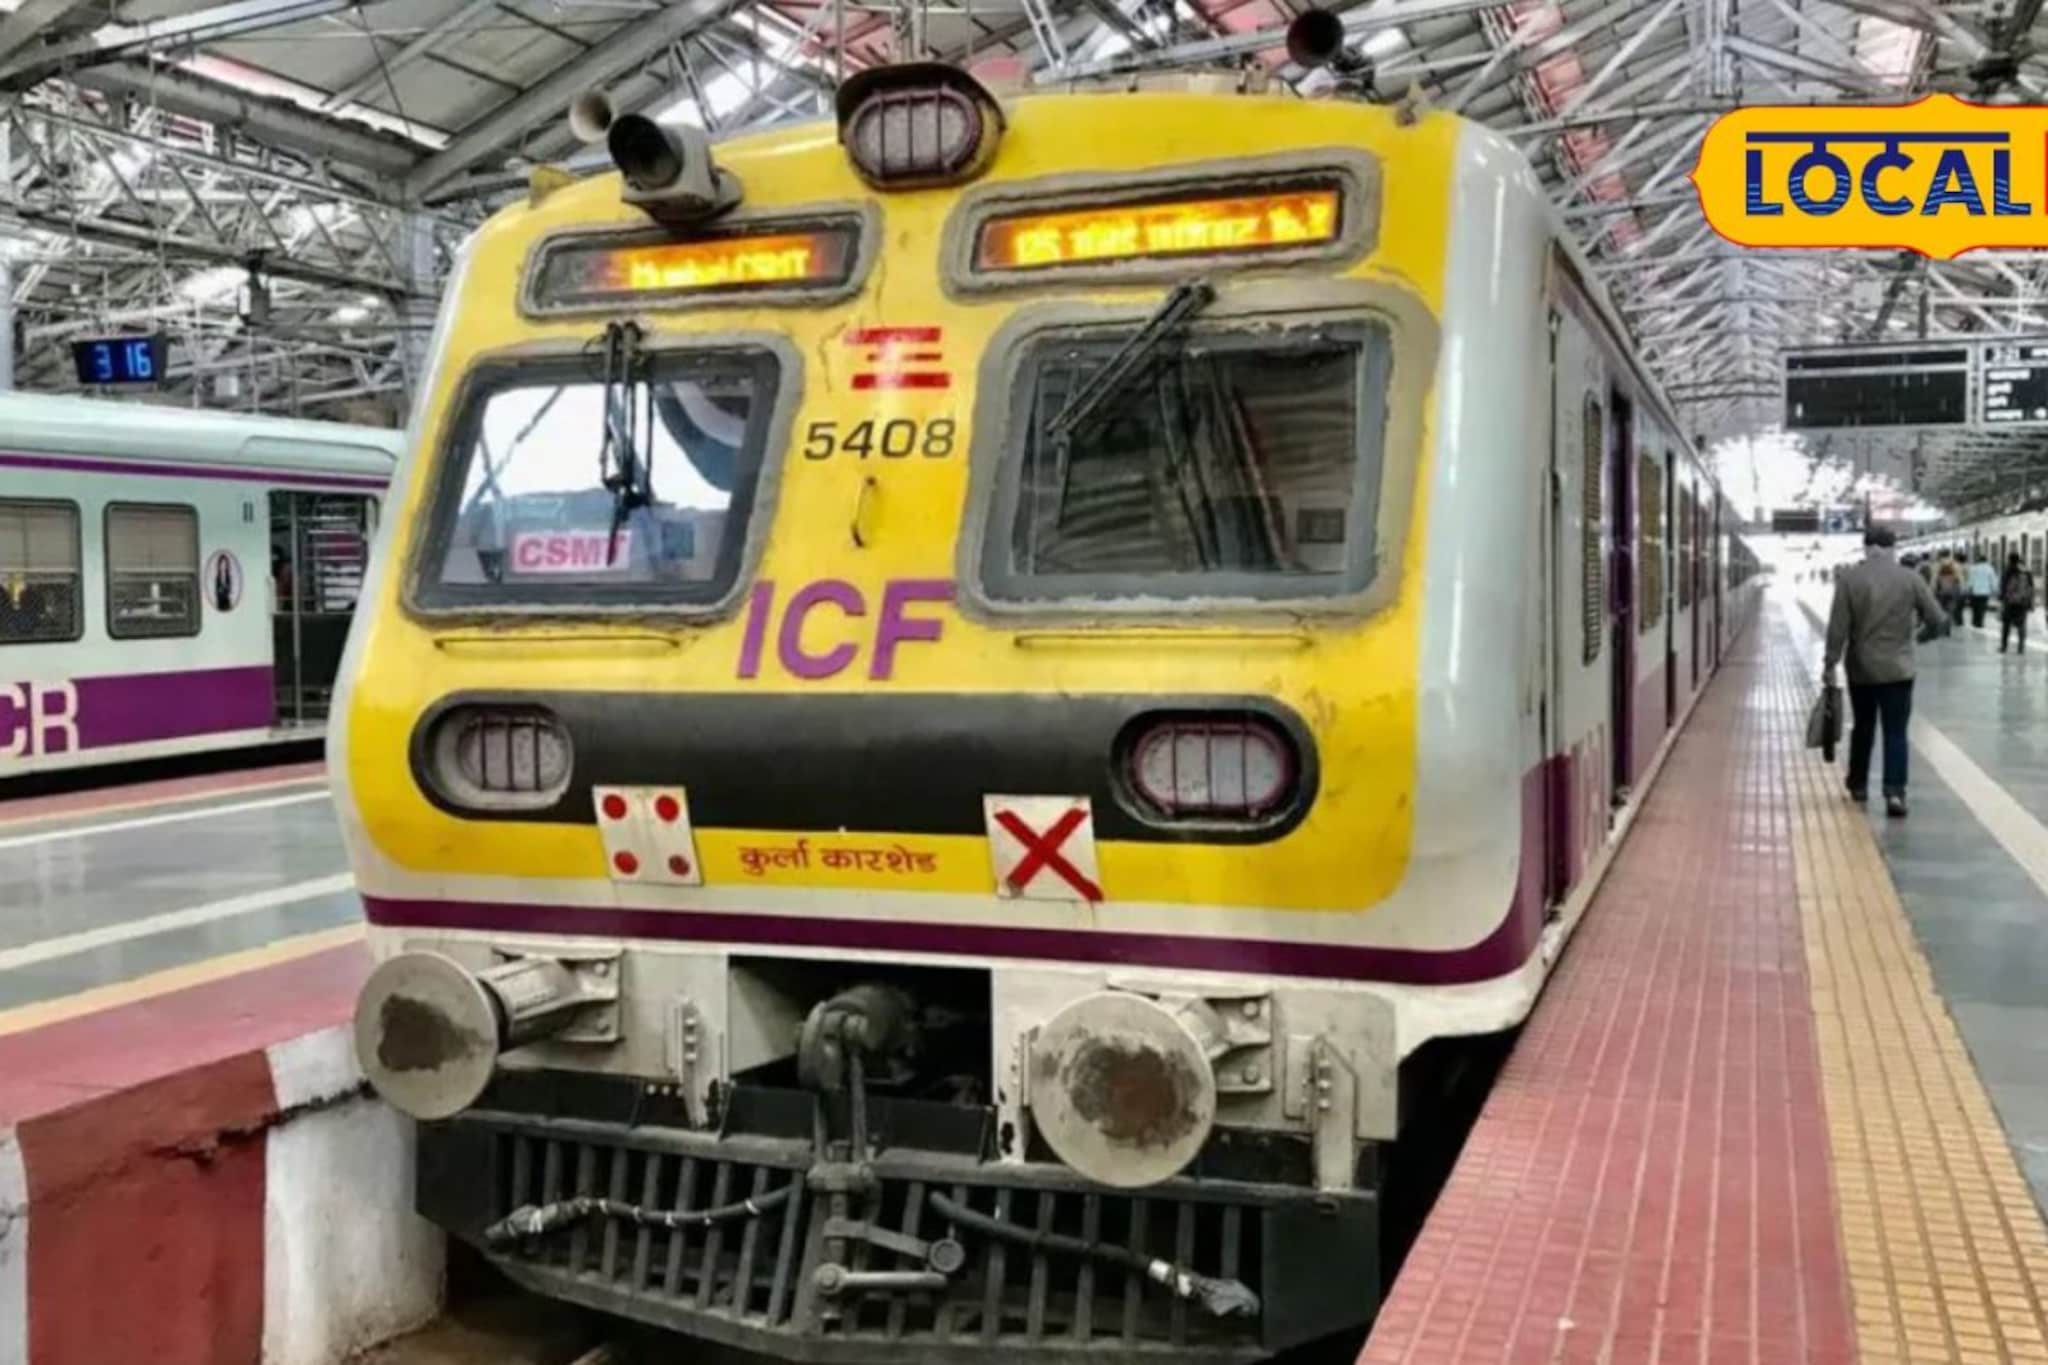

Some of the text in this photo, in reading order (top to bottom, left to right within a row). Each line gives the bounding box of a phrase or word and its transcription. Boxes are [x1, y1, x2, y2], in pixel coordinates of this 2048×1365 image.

[803, 418, 956, 461] 5408
[736, 579, 957, 681] ICF
[738, 838, 938, 876] कुर्ला कारशेड
